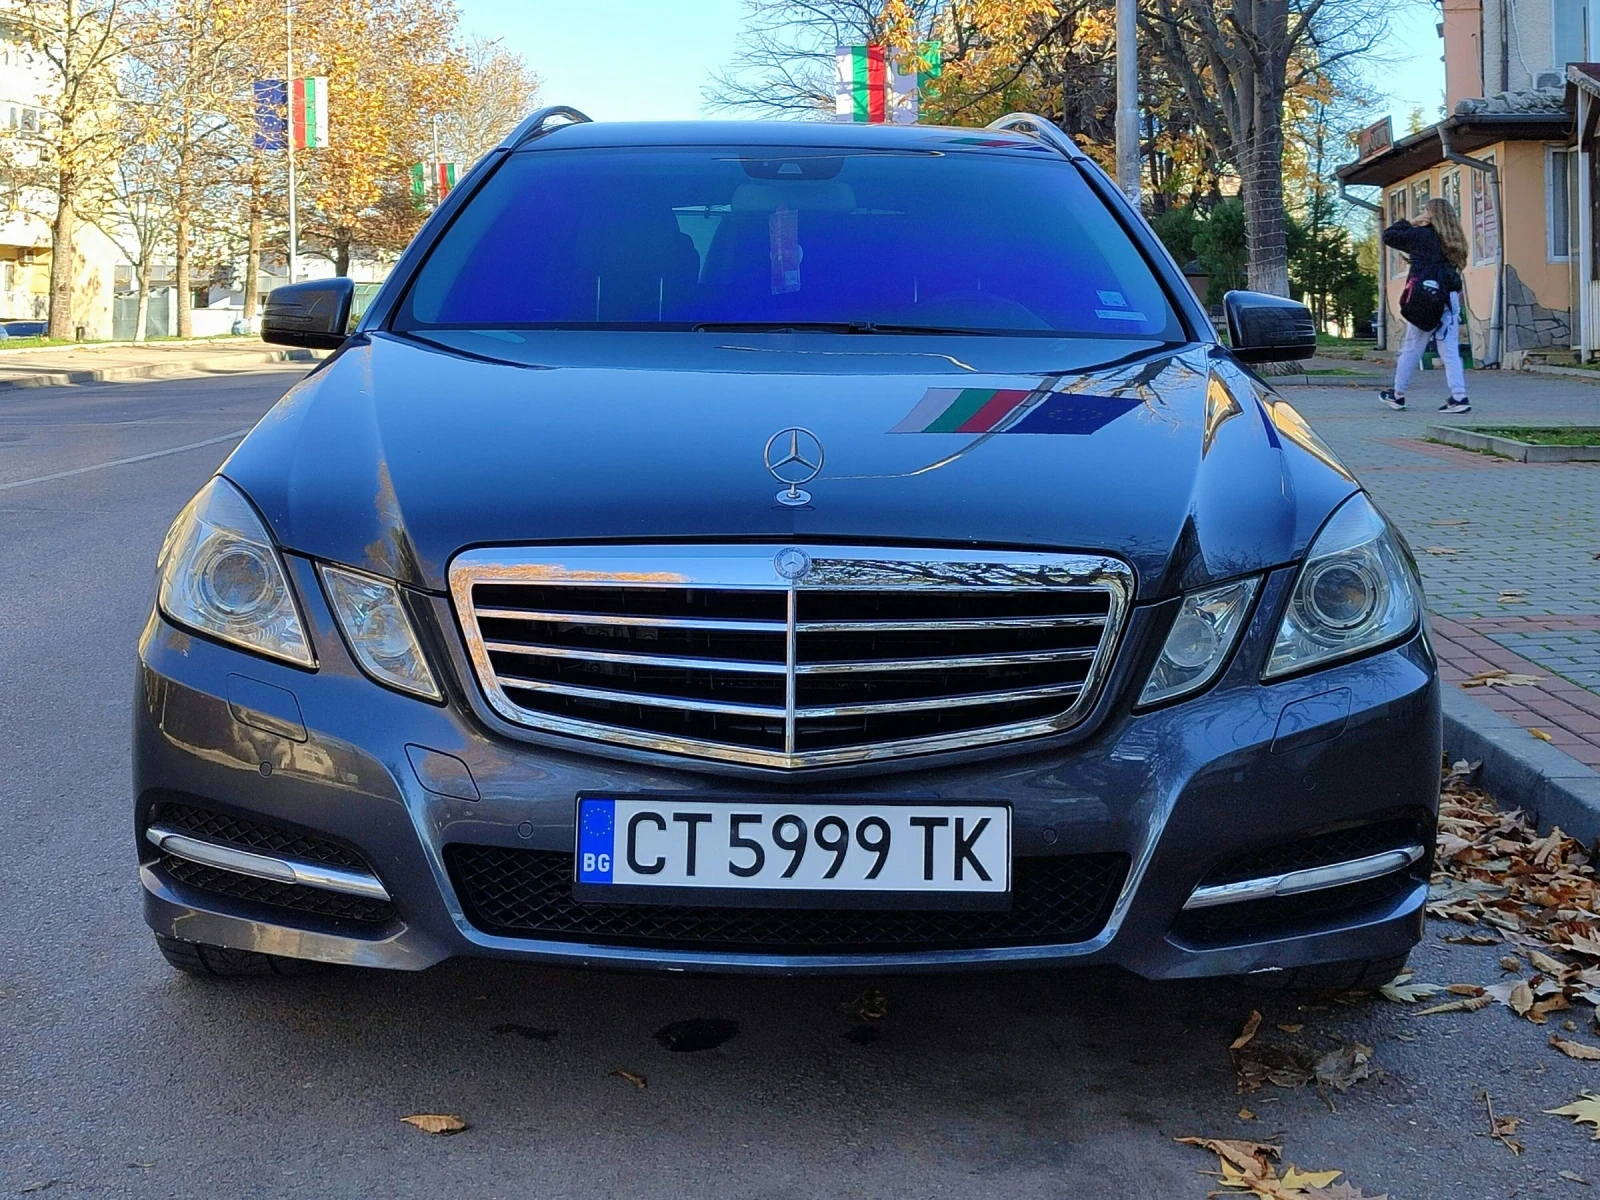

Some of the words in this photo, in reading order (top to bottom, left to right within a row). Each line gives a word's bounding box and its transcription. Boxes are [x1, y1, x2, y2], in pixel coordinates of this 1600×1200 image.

[583, 853, 611, 872] BG
[627, 811, 713, 877] CT
[729, 813, 892, 880] 5999
[909, 816, 993, 882] TK
